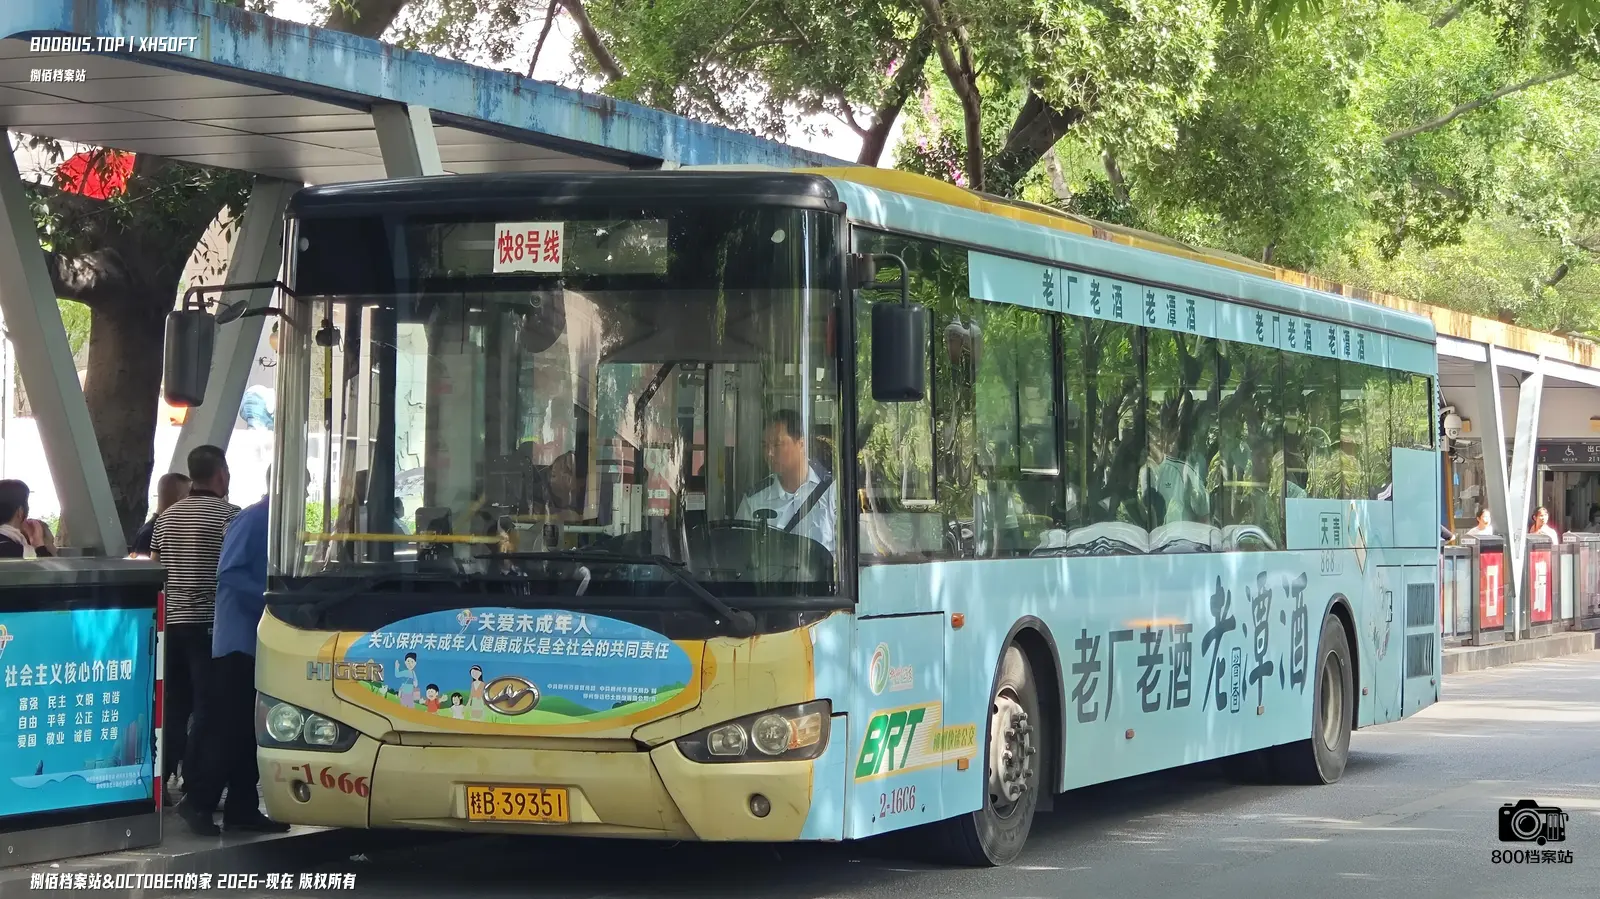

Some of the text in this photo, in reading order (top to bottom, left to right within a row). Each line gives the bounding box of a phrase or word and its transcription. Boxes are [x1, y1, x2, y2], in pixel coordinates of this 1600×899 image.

[497, 229, 560, 265] 快8号线
[1042, 268, 1196, 332] 老厂老酒 老潭酒
[1255, 310, 1365, 361] 老厂老酒 老潭酒
[1321, 517, 1340, 546] 天青
[478, 612, 592, 634] 关爱未成年人
[368, 632, 670, 659] 关心保护未成年人健康成长是全社会的共同责任
[1071, 570, 1308, 723] 老厂老酒 老潭酒
[5, 660, 132, 688] 社会主义核心价值观
[306, 661, 385, 681] HIGER
[19, 691, 120, 711] 富强 民主 文明 和谐
[18, 709, 119, 730] 自由 平等 公正 法治
[17, 727, 118, 748] 爱国 敬业 诚信 友善
[855, 708, 926, 778] BRT
[272, 760, 370, 798] 2-1666
